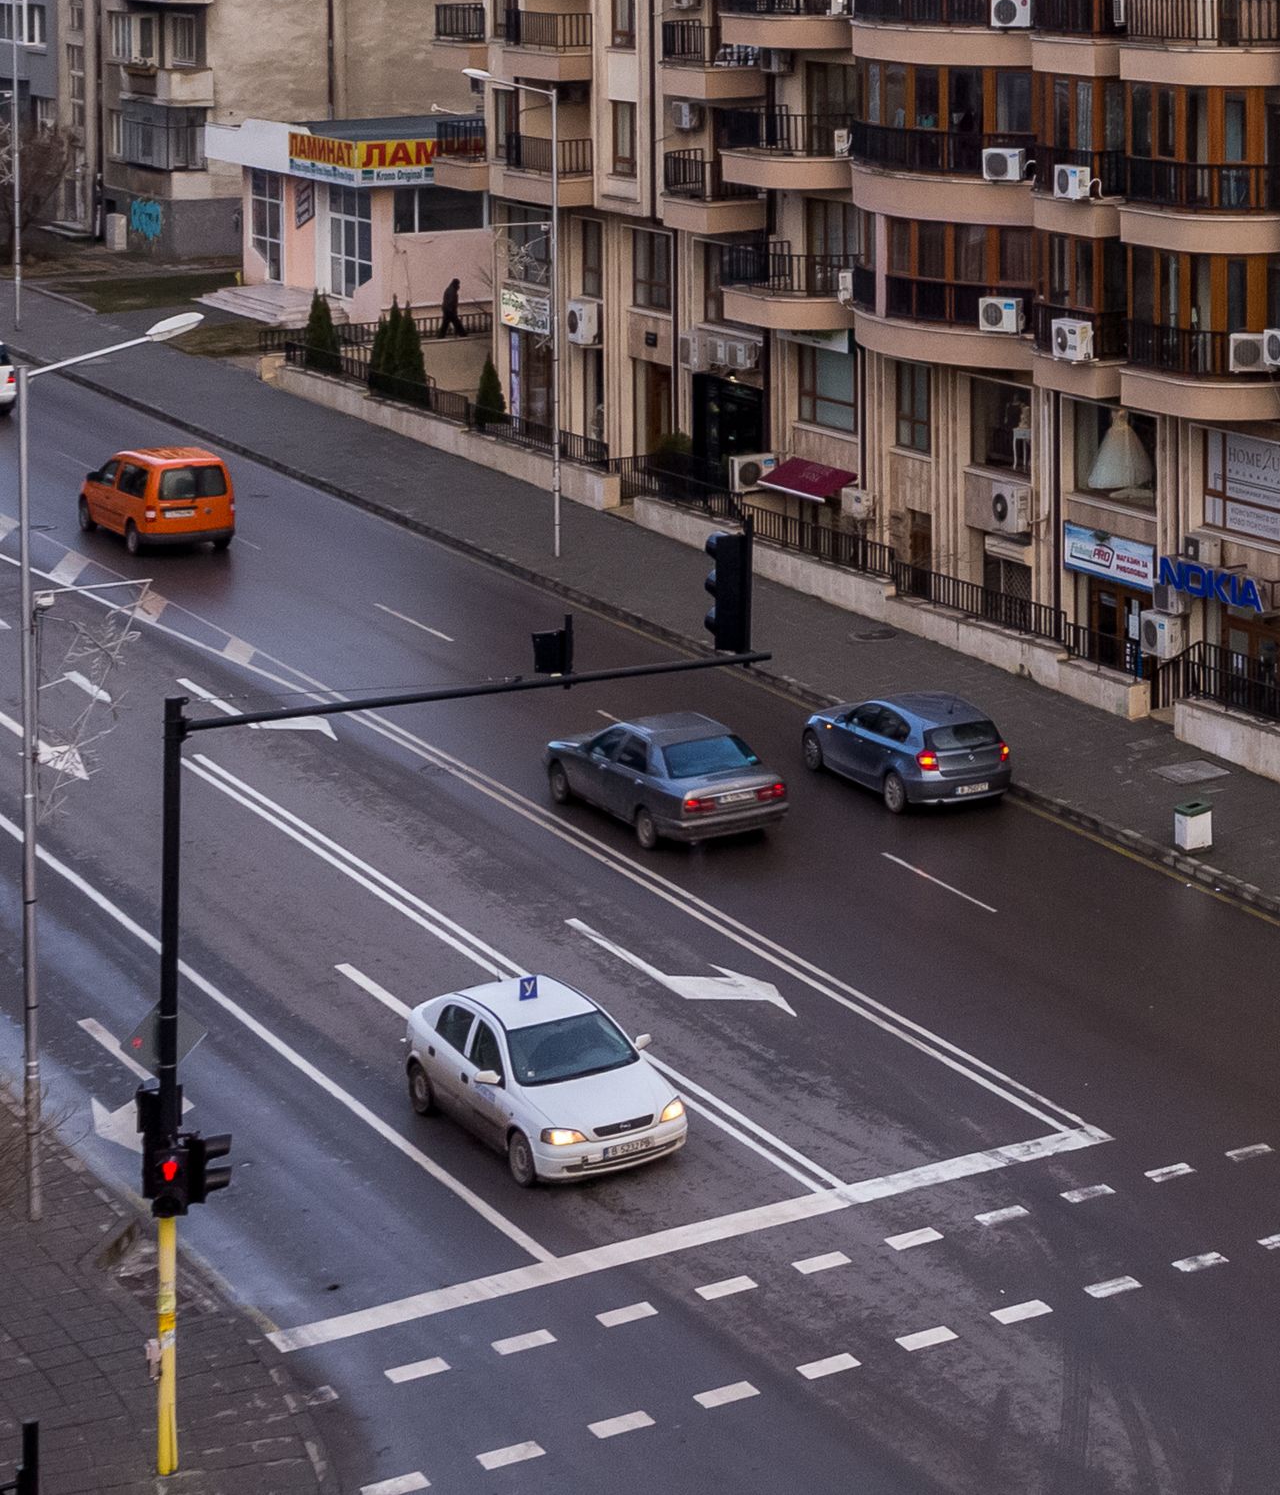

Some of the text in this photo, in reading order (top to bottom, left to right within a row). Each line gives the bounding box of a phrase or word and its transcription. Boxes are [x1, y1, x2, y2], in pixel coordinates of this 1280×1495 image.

[289, 133, 354, 168] ЛАМИНАТ
[1092, 546, 1110, 563] PRO
[1159, 556, 1265, 613] NOKIA
